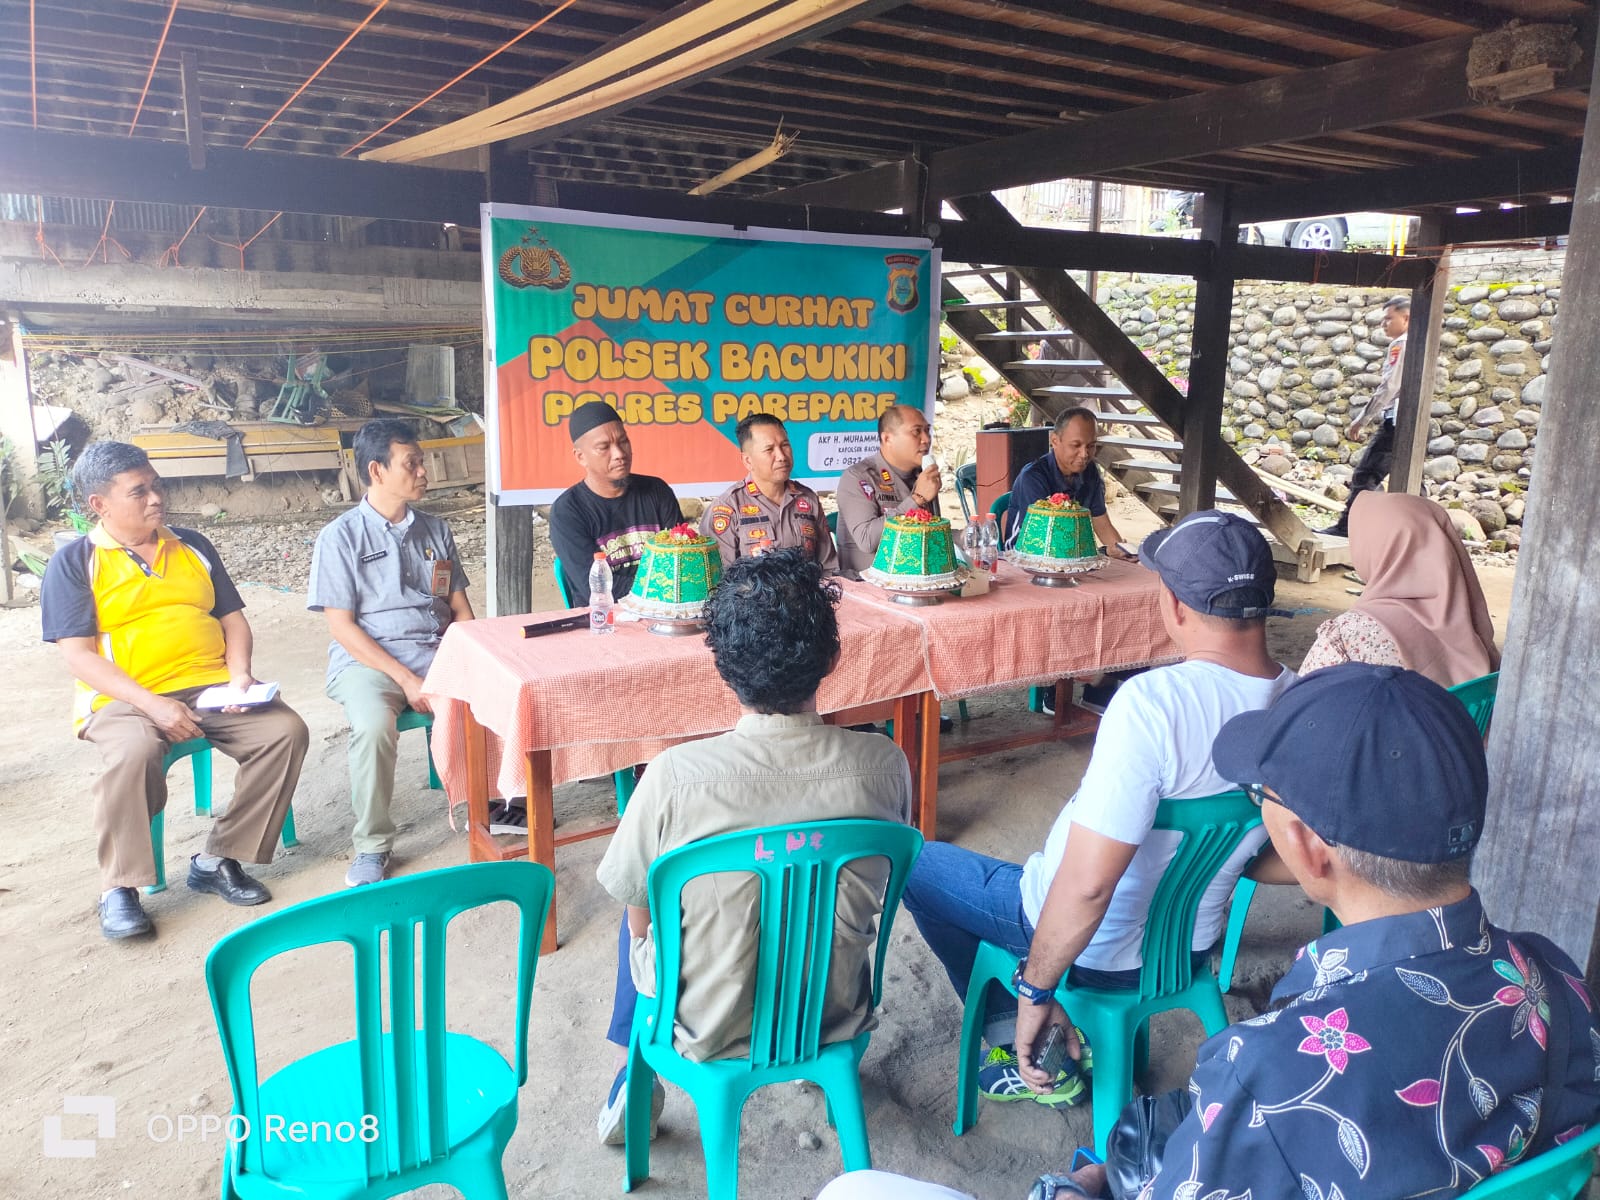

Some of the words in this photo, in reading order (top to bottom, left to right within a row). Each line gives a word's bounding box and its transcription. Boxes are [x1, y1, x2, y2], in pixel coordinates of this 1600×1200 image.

[572, 284, 715, 325] JUMAT
[724, 292, 876, 329] CURHAT
[528, 335, 711, 383] POLSEK
[720, 341, 907, 382] BACUKIKI
[818, 435, 831, 445] AKP
[834, 435, 841, 444] H.
[844, 434, 880, 443] MUHAMMA
[823, 457, 834, 467] CP
